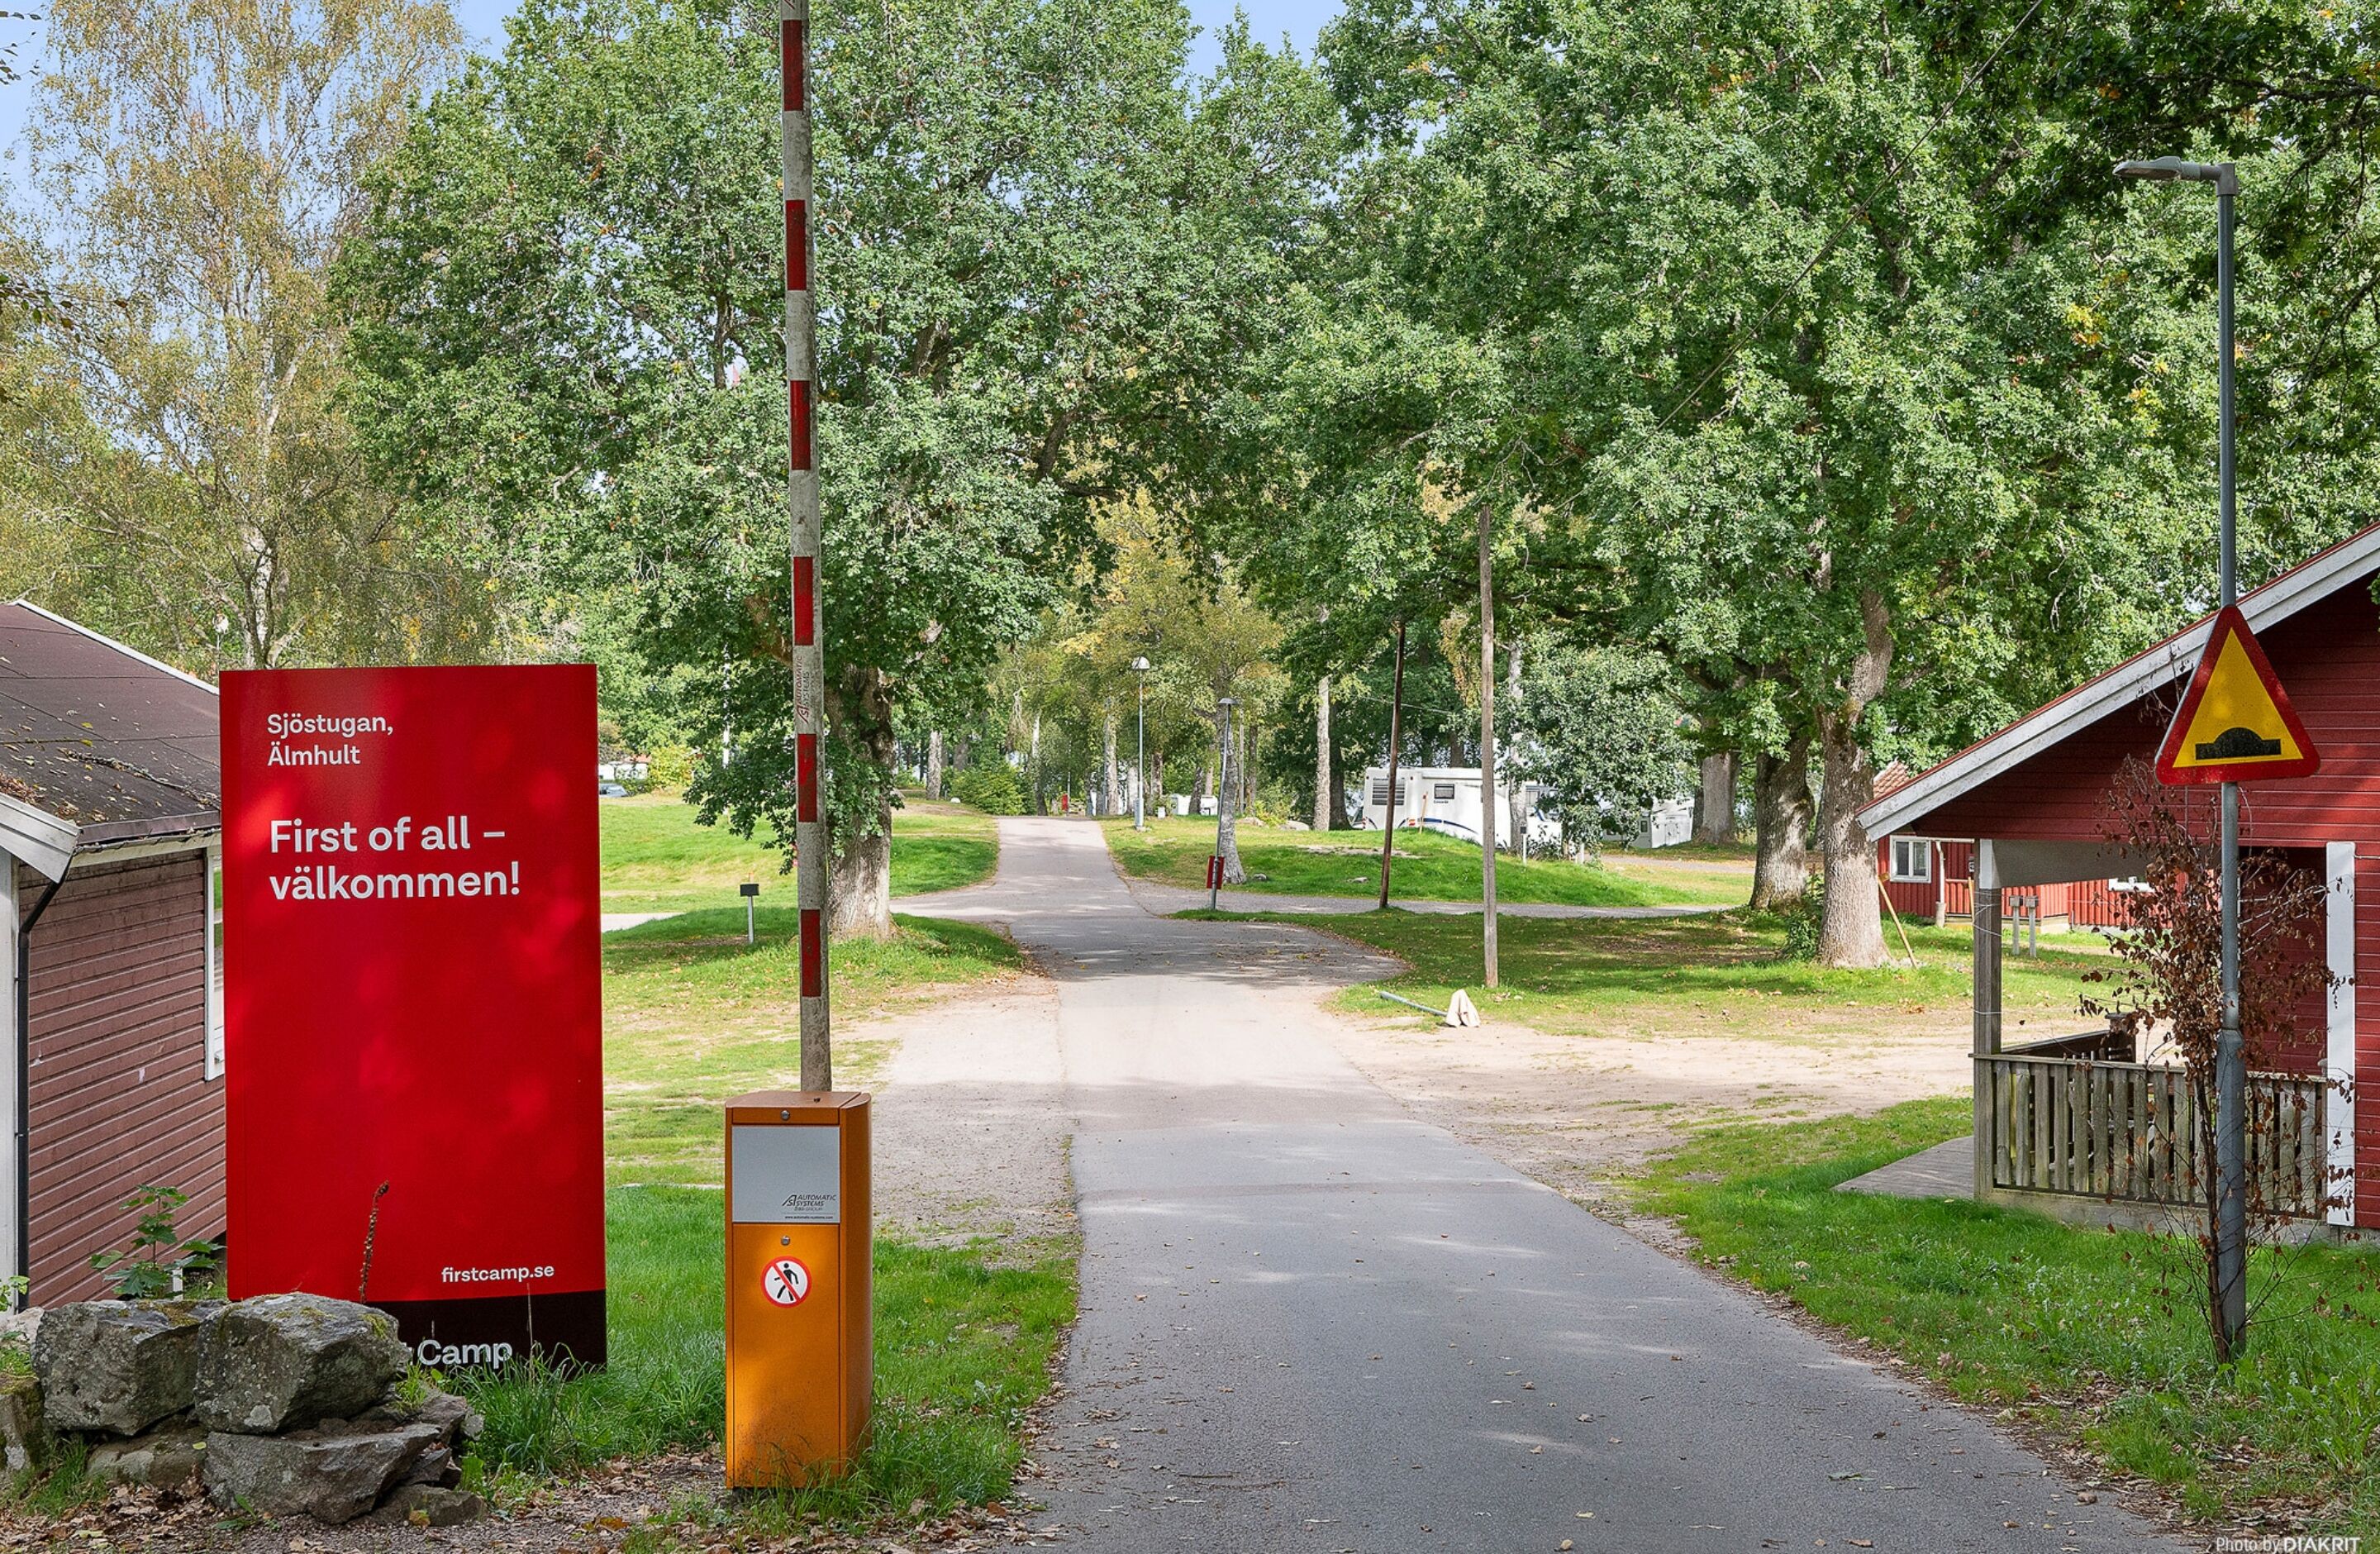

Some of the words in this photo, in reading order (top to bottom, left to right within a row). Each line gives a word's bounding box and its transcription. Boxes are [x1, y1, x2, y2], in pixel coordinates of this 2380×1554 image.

[267, 713, 393, 738] Sjöstugan,
[267, 741, 361, 766] Älmhult
[270, 818, 358, 853] First
[368, 816, 412, 851] of
[421, 815, 471, 851] all
[269, 860, 520, 900] välkommen!
[440, 1266, 555, 1283] firstcamp.se
[416, 1339, 513, 1370] Camp
